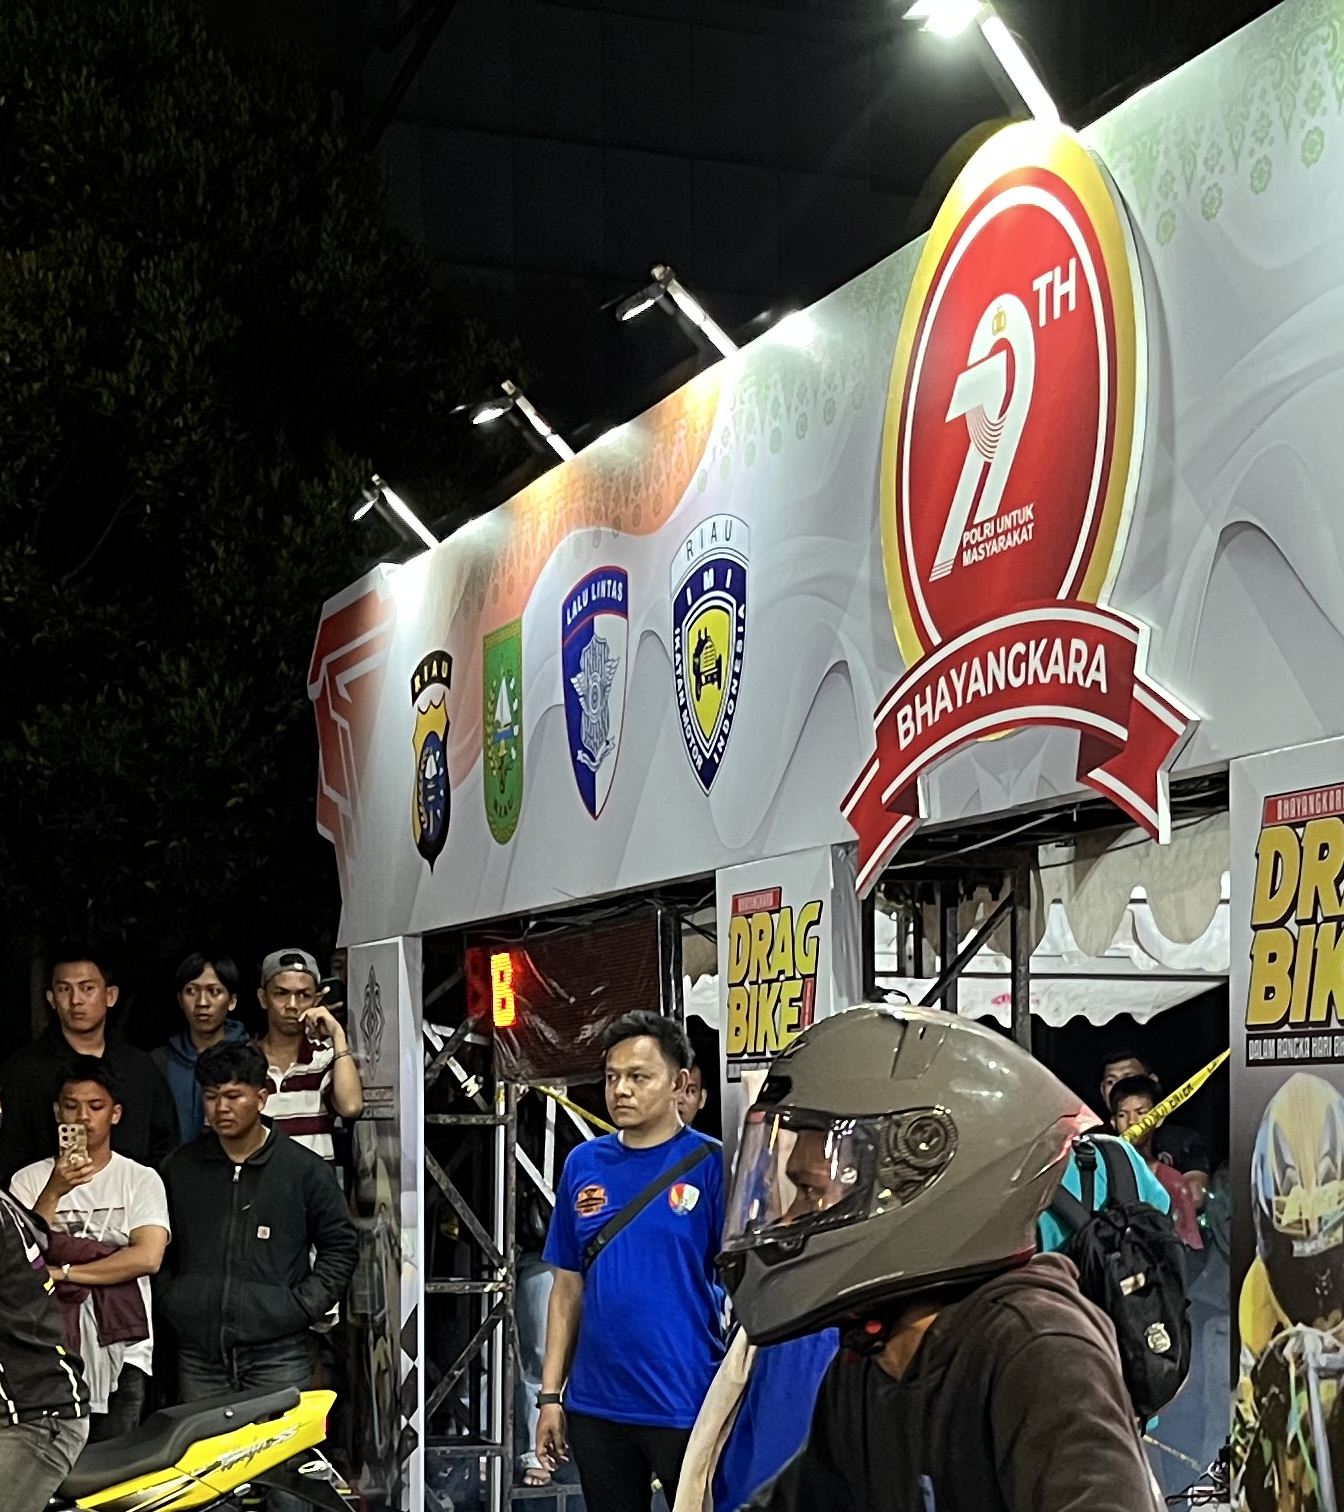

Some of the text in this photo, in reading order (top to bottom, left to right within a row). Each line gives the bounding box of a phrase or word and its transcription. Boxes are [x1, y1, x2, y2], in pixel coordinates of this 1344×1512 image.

[1032, 258, 1078, 328] TH
[686, 519, 734, 562] RIAU
[962, 502, 1035, 548] POLRI UNTUK
[962, 522, 1035, 567] MASYARAKAT
[566, 578, 624, 626] LALU LINTAS
[686, 567, 734, 606] IMI
[414, 659, 449, 693] RIAU
[673, 627, 704, 772] IKATAN MOTOR
[713, 603, 746, 765] INDONESIA
[895, 636, 1109, 752] BHAYANGKARA
[727, 900, 824, 986] DRAG
[726, 979, 804, 1057] BIKE
